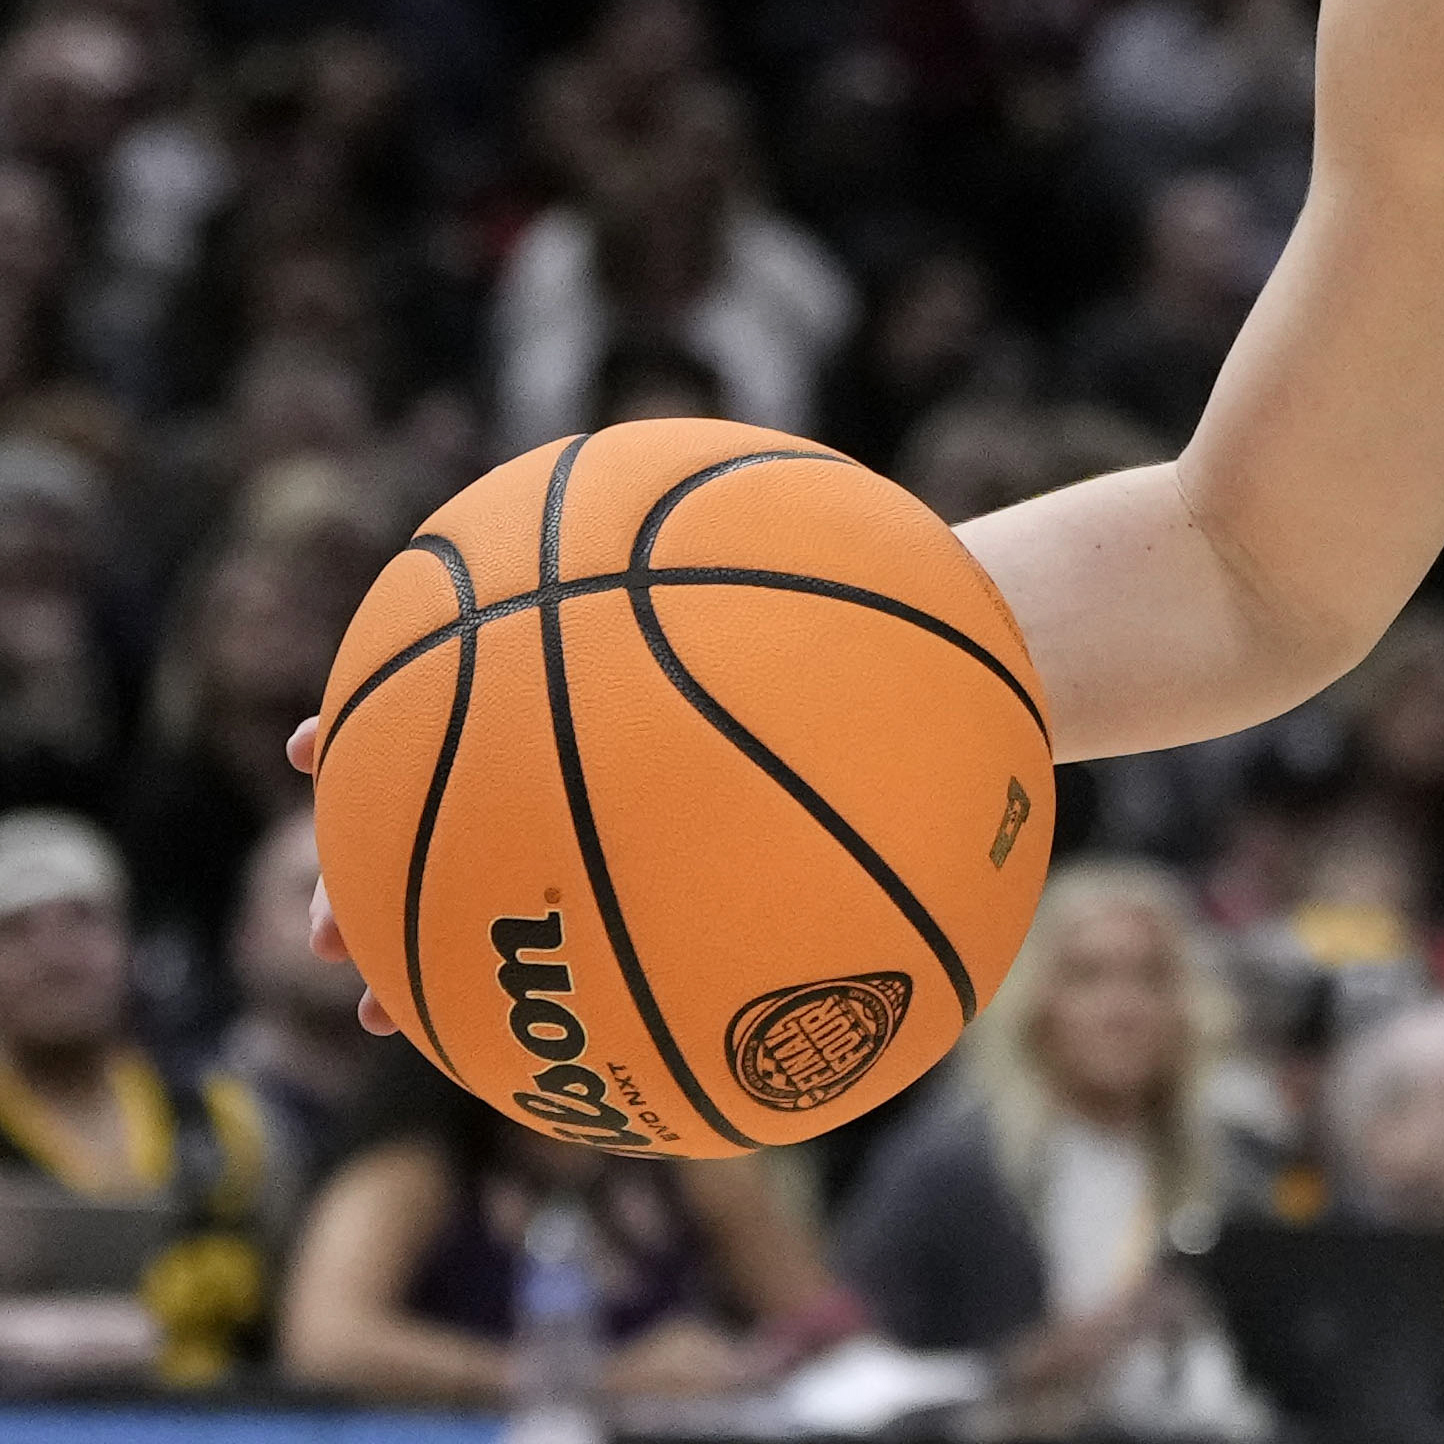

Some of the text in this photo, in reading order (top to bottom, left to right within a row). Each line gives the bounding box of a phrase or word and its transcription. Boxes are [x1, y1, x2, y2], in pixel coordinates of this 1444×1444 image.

[488, 909, 680, 1158] ilson
[764, 1020, 833, 1092] FINAL
[799, 994, 874, 1072] FOUR
[605, 1060, 682, 1144] EVO NXT
